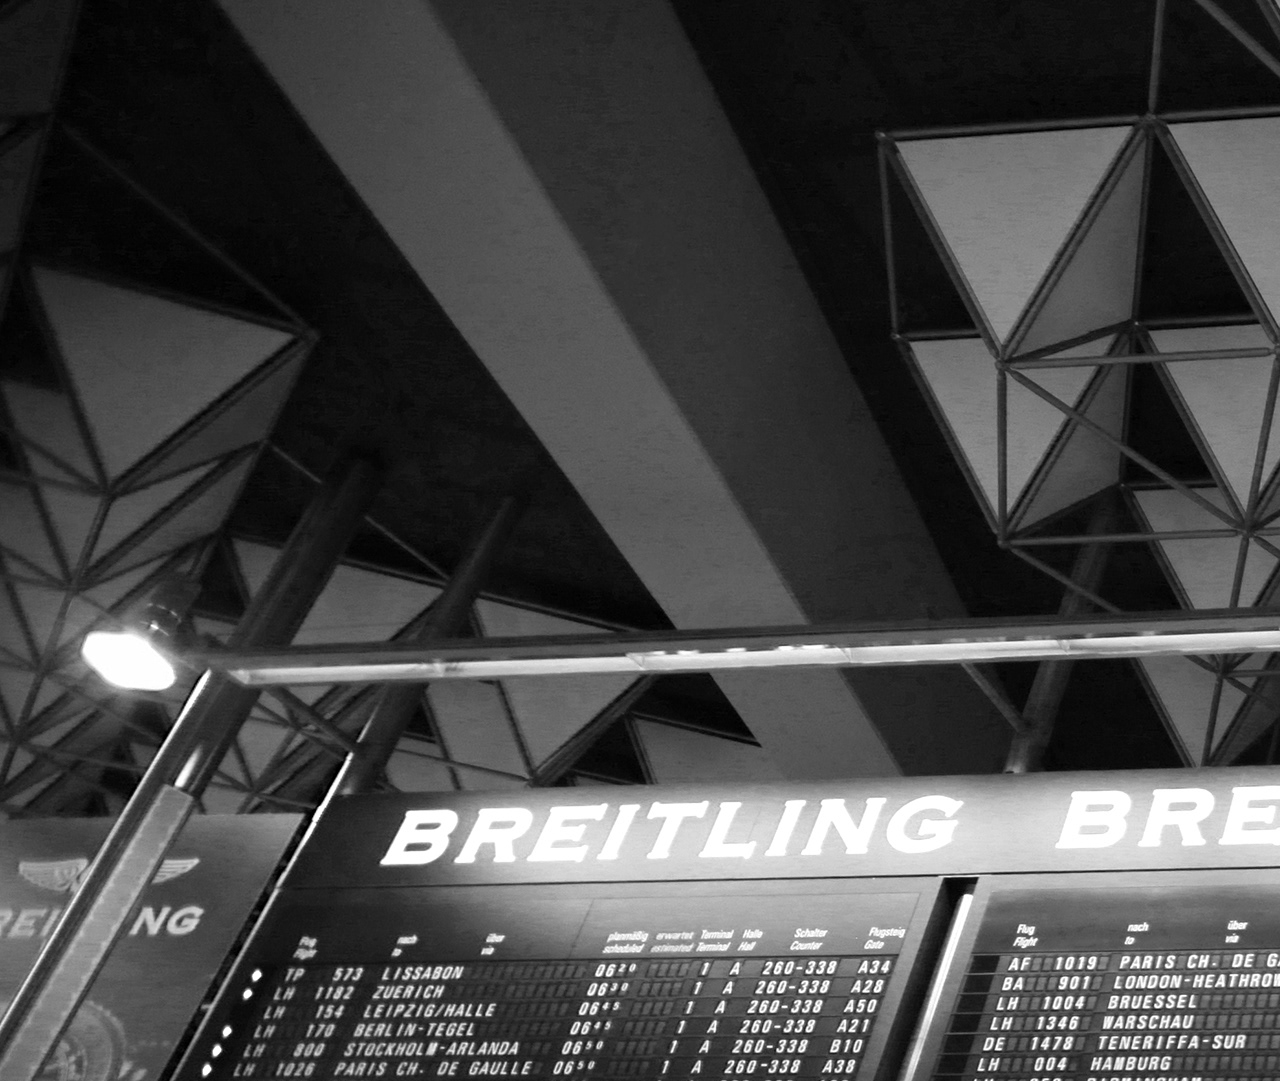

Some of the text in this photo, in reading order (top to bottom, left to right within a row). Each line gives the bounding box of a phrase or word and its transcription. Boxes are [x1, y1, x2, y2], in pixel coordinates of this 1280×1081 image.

[379, 797, 966, 868] BREITLING
[1119, 955, 1176, 969] PARIS
[1232, 954, 1255, 968] DE
[382, 960, 890, 980] LISSABON 260-338 A34
[372, 985, 445, 999] ZUERICH
[364, 1003, 496, 1018] LEIPZIG/HALLE
[1103, 1015, 1194, 1029] WARSCHAU
[344, 1041, 519, 1056] STOCKHOLM-ARLANDA
[1099, 1035, 1246, 1050] TENERIFFA-SUR
[334, 1062, 387, 1076] PARIS
[437, 1061, 459, 1075] DE
[469, 1061, 532, 1075] GAULLE
